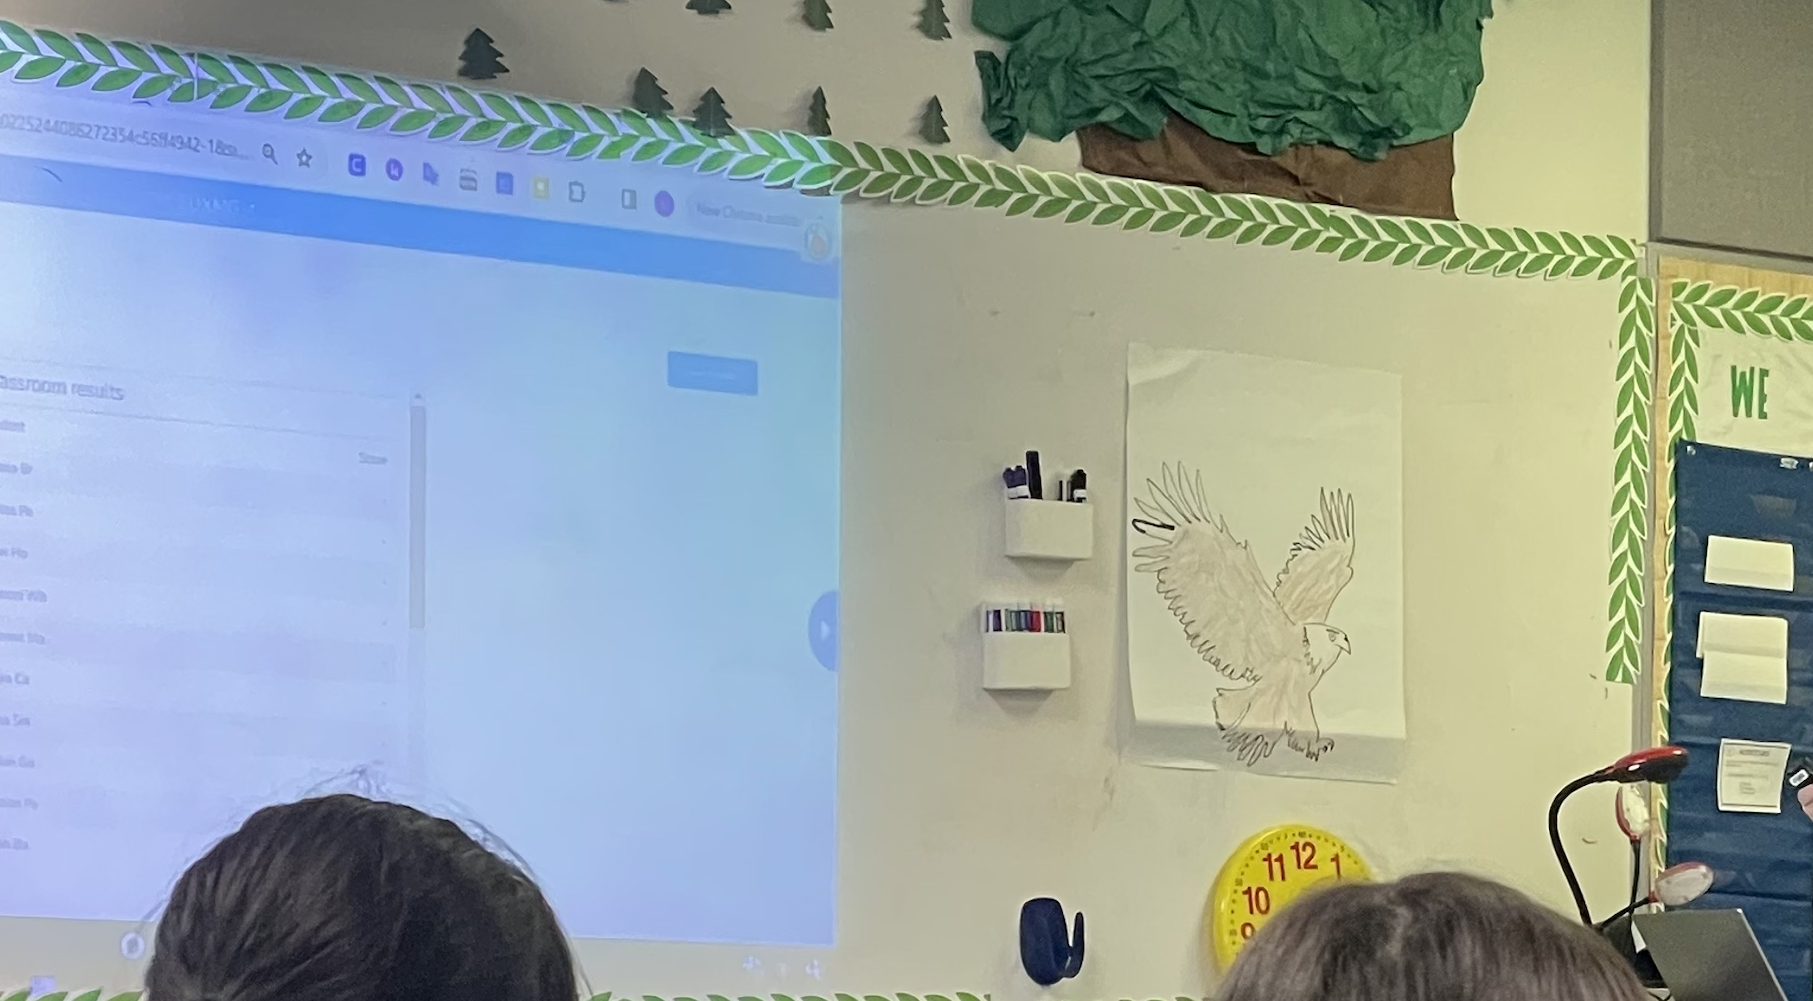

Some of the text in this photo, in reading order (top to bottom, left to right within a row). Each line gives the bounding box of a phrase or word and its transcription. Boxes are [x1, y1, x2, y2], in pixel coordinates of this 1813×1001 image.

[1730, 365, 1769, 420] WE
[1262, 853, 1286, 881] 11
[1290, 841, 1318, 870] 12
[1330, 853, 1341, 880] 1
[1242, 886, 1270, 915] 10
